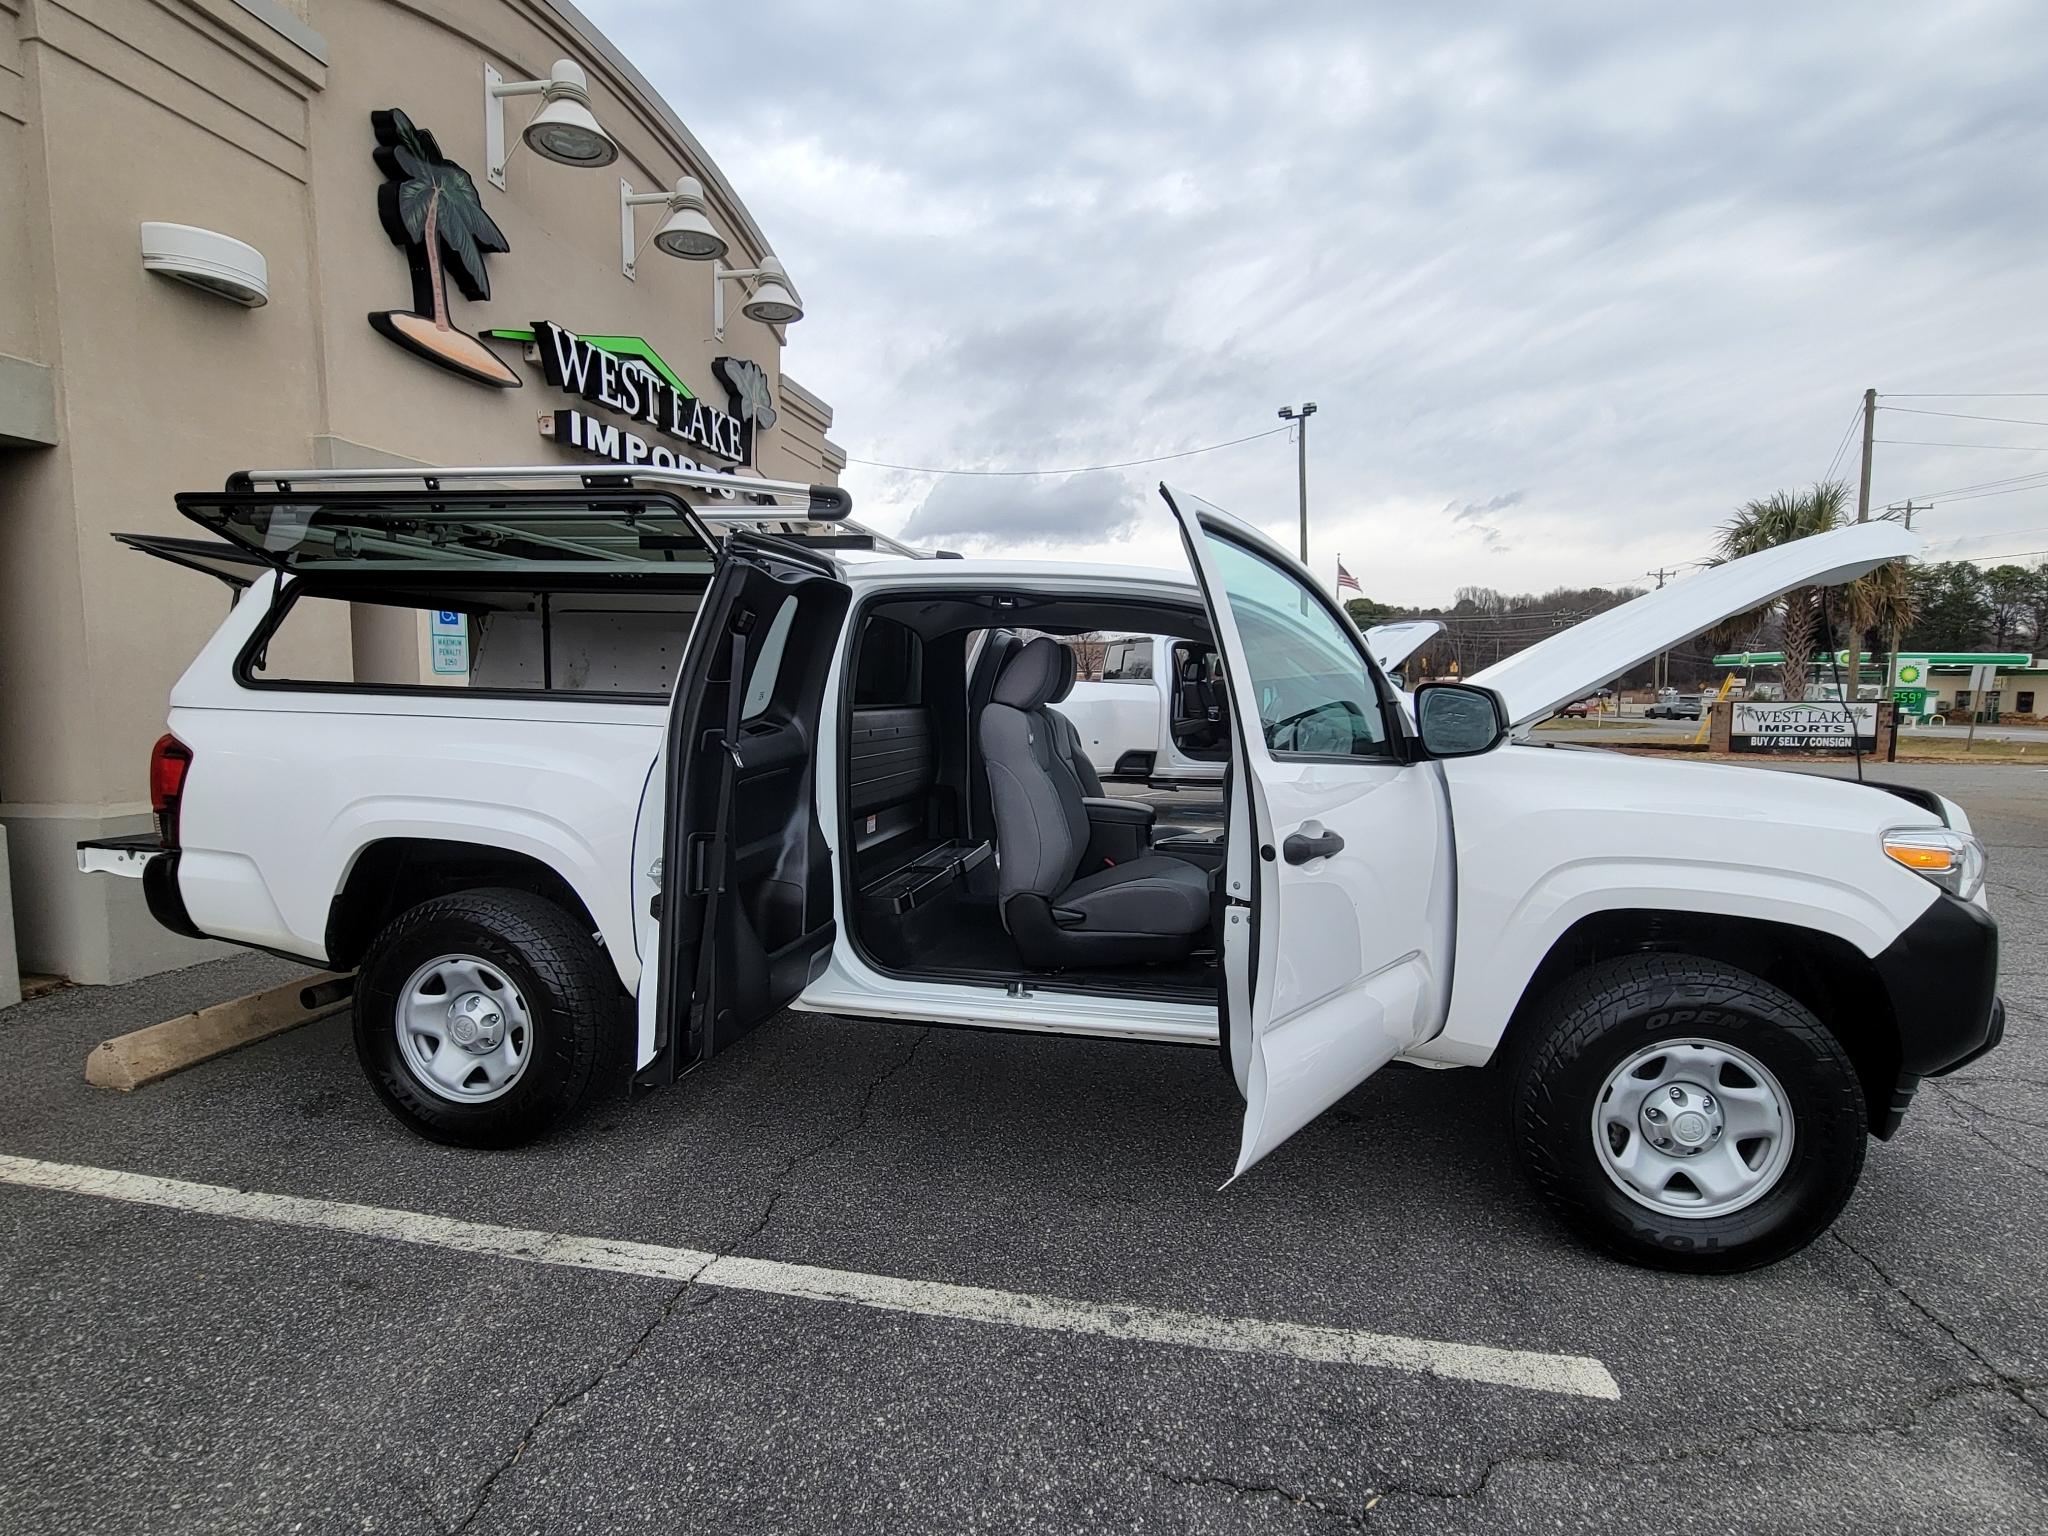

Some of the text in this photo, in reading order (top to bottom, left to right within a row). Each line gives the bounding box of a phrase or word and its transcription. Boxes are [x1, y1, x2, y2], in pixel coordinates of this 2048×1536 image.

[547, 320, 744, 463] WEST LAKE
[1754, 710, 1803, 723] WEST
[1758, 724, 1846, 733] IMPORTS
[1750, 736, 1770, 747] BUY
[1778, 737, 1801, 747] SELL
[1809, 737, 1853, 748] CONSIGN
[1645, 1008, 1750, 1031] OPEN
